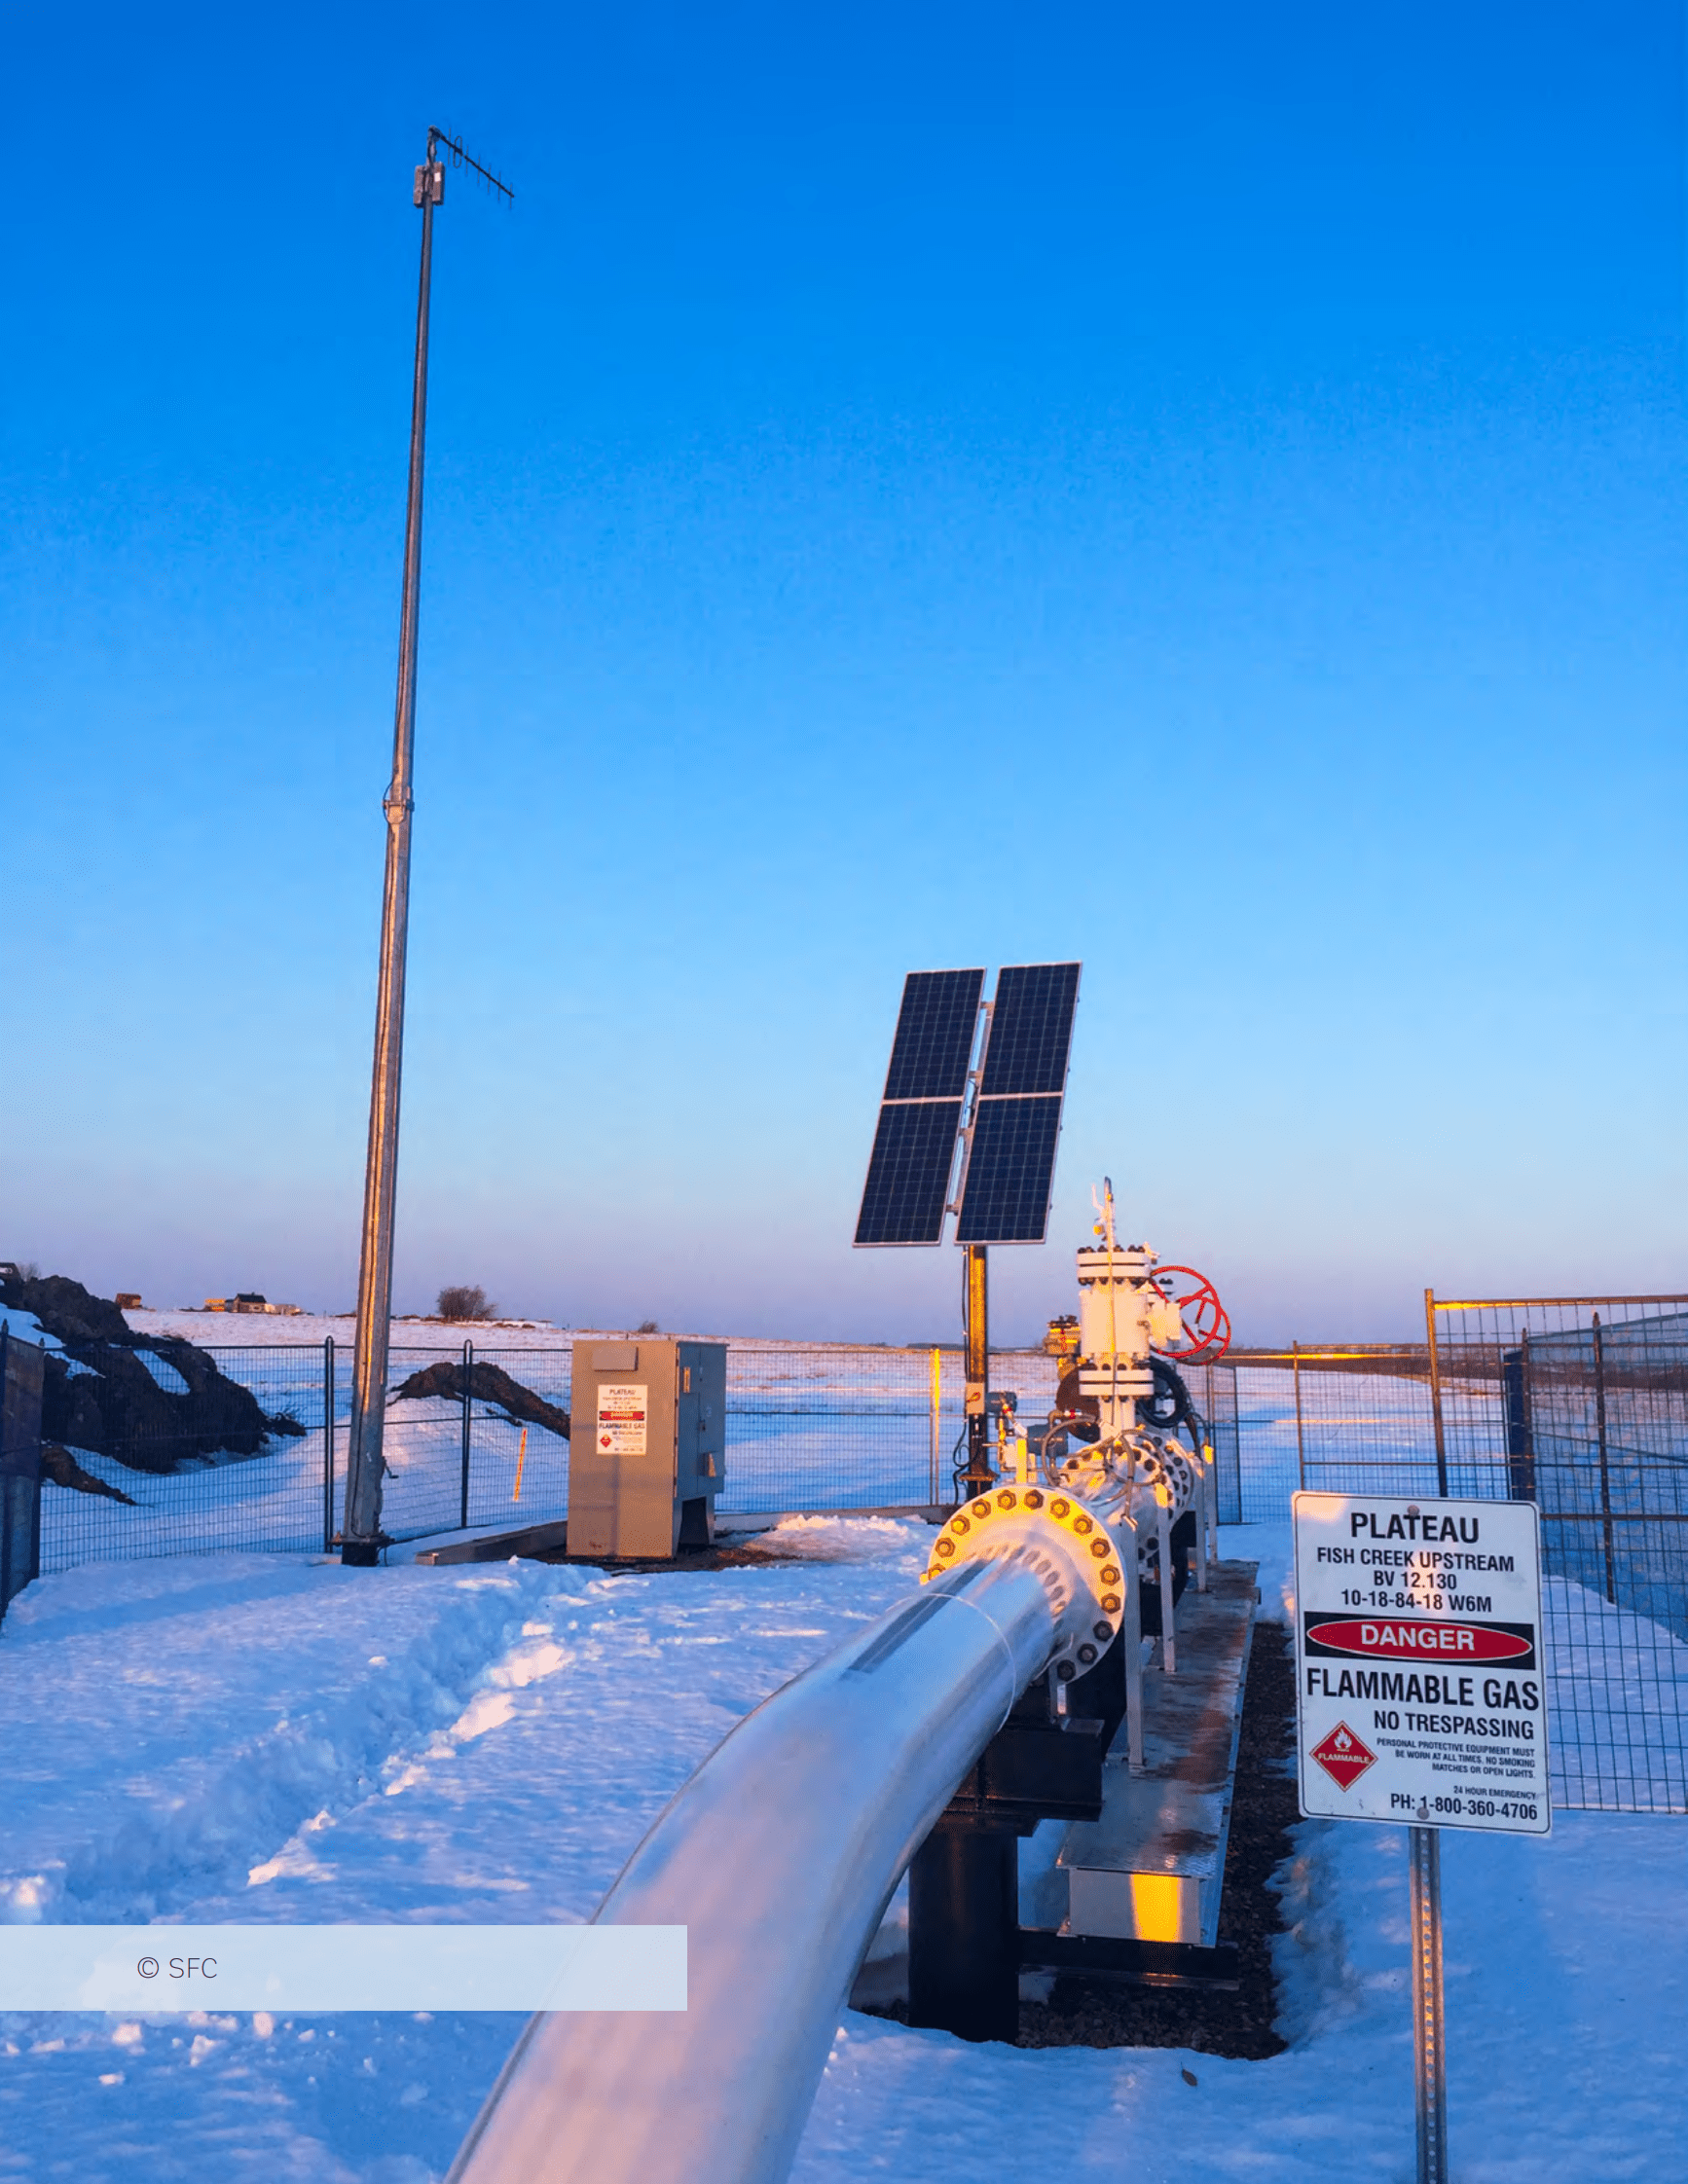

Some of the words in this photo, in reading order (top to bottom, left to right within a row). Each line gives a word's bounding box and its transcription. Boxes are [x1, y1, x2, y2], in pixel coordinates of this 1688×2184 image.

[1350, 1512, 1479, 1544] PLATEAU
[1317, 1547, 1354, 1564] FISH
[1360, 1548, 1414, 1567] CREEK
[1419, 1551, 1514, 1572] UPSTREAM
[1374, 1570, 1395, 1586] BV
[1401, 1572, 1457, 1589] 12.130
[1341, 1589, 1443, 1610] 10-18-84-18
[1449, 1594, 1491, 1613] W6M
[1361, 1624, 1475, 1651] DANGER
[1306, 1667, 1475, 1707] FLAMMABLE
[1484, 1679, 1539, 1711] GAS
[1374, 1710, 1400, 1729] NO
[1405, 1713, 1534, 1740] TRESPASSING
[1318, 1753, 1369, 1764] FLAMMABLE
[1376, 1737, 1416, 1748] PERSONAL
[1418, 1741, 1464, 1752] PROTECTIVE
[1466, 1744, 1511, 1755] EQUIPMENT
[1512, 1747, 1535, 1757] MUST
[1395, 1749, 1405, 1758] BE
[1407, 1750, 1431, 1760] WORN
[1432, 1752, 1442, 1761] AT
[1486, 1756, 1497, 1765] NO
[1499, 1757, 1535, 1767] SMOKING
[1432, 1763, 1468, 1773] MATCHES
[1470, 1765, 1482, 1773] OR
[1483, 1766, 1504, 1776] OPEN
[1465, 1786, 1487, 1797] HOUR
[1488, 1788, 1536, 1801] EMERGENCY
[1390, 1793, 1415, 1810] PH:
[1419, 1796, 1538, 1820] 1-800-360-4706
